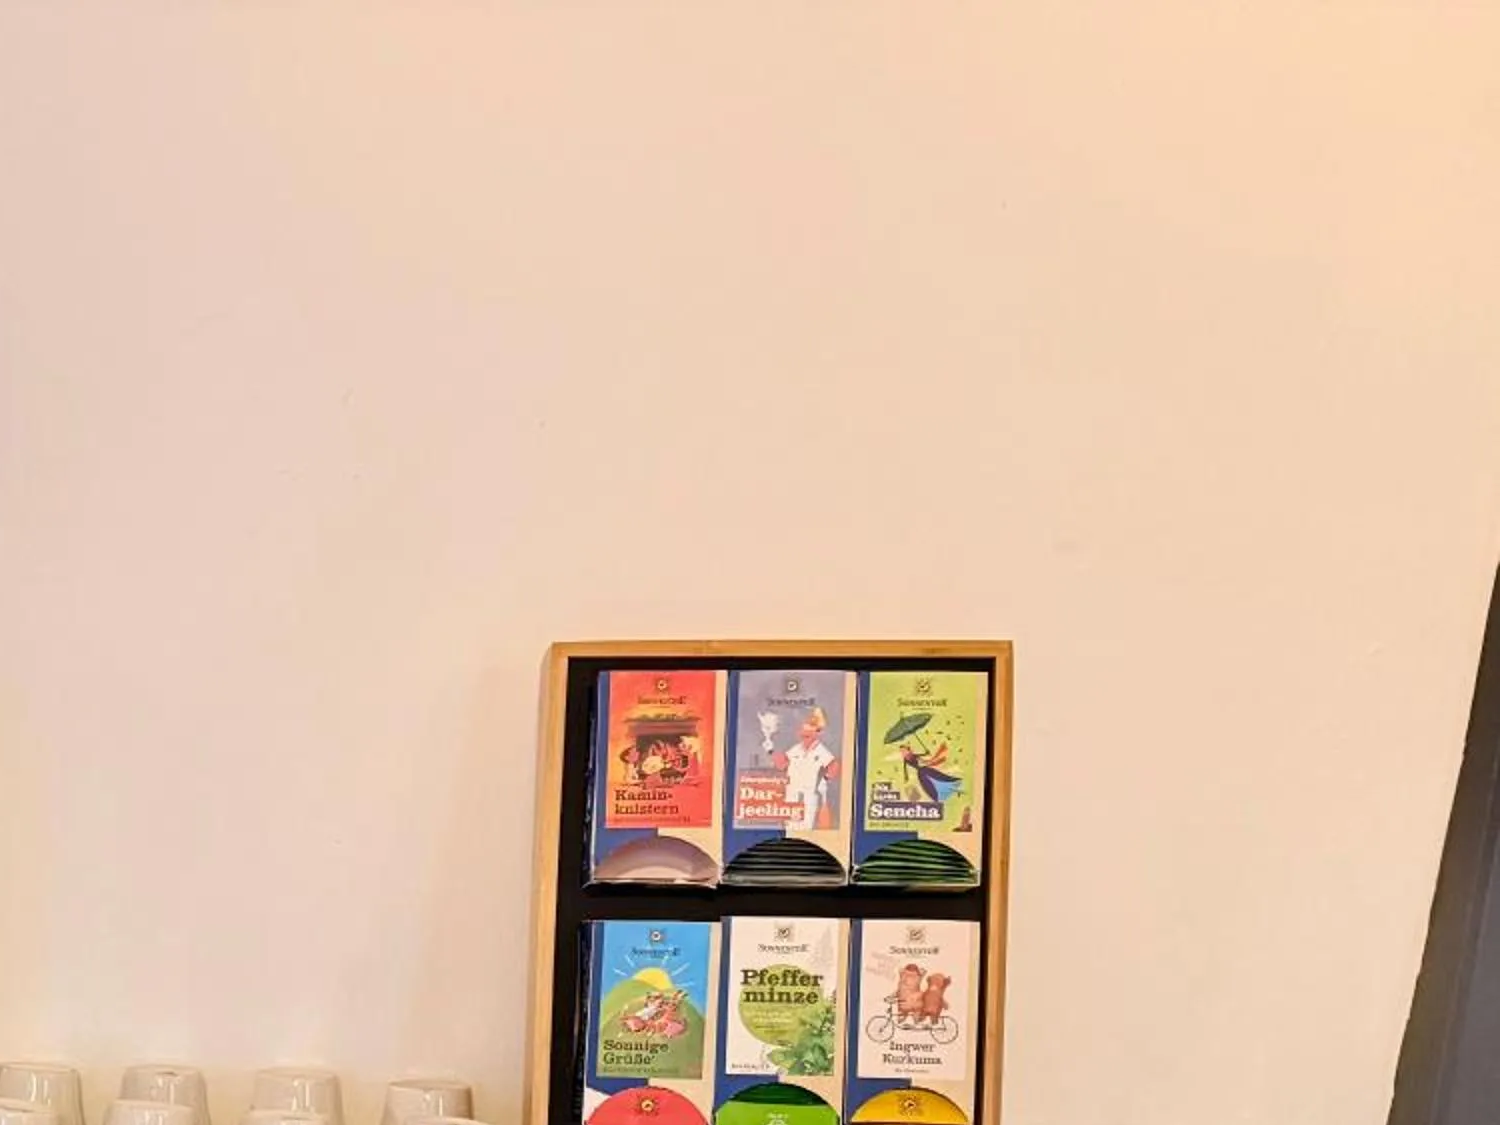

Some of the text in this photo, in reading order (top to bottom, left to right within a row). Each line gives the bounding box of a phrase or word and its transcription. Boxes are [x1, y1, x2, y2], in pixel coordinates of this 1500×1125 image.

[614, 803, 680, 815] knistern
[738, 803, 803, 819] jeeling
[870, 803, 940, 819] Sencha
[740, 969, 824, 987] Pfeffer
[743, 987, 819, 1004] minze
[603, 1040, 669, 1054] Sonnige
[889, 1041, 936, 1056] Ingwer
